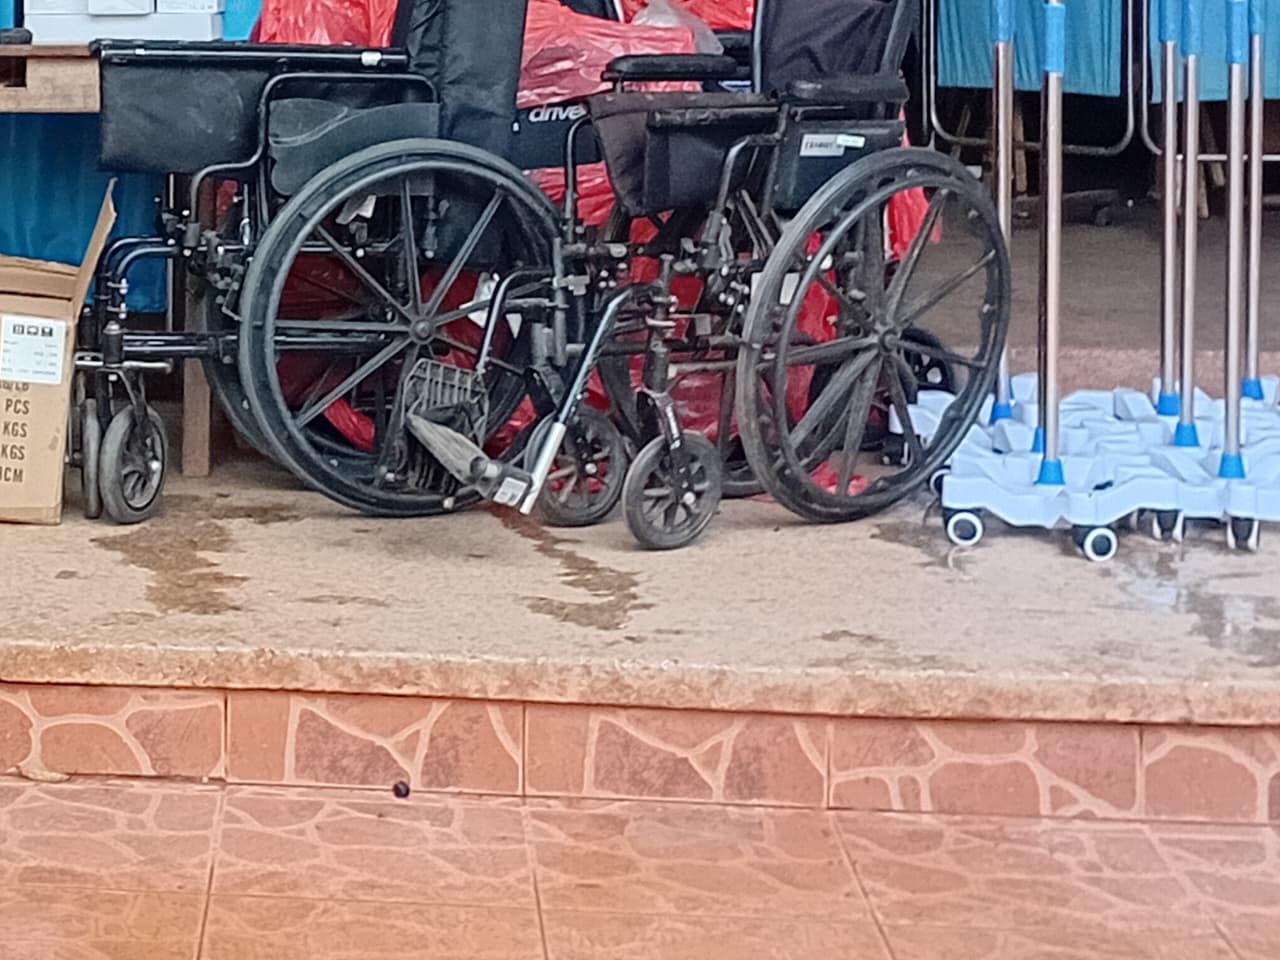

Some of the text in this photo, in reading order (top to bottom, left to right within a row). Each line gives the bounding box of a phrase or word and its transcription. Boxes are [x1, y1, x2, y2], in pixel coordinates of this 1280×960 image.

[4, 398, 31, 416] PCS
[2, 421, 28, 438] KGS
[0, 443, 26, 461] KGS
